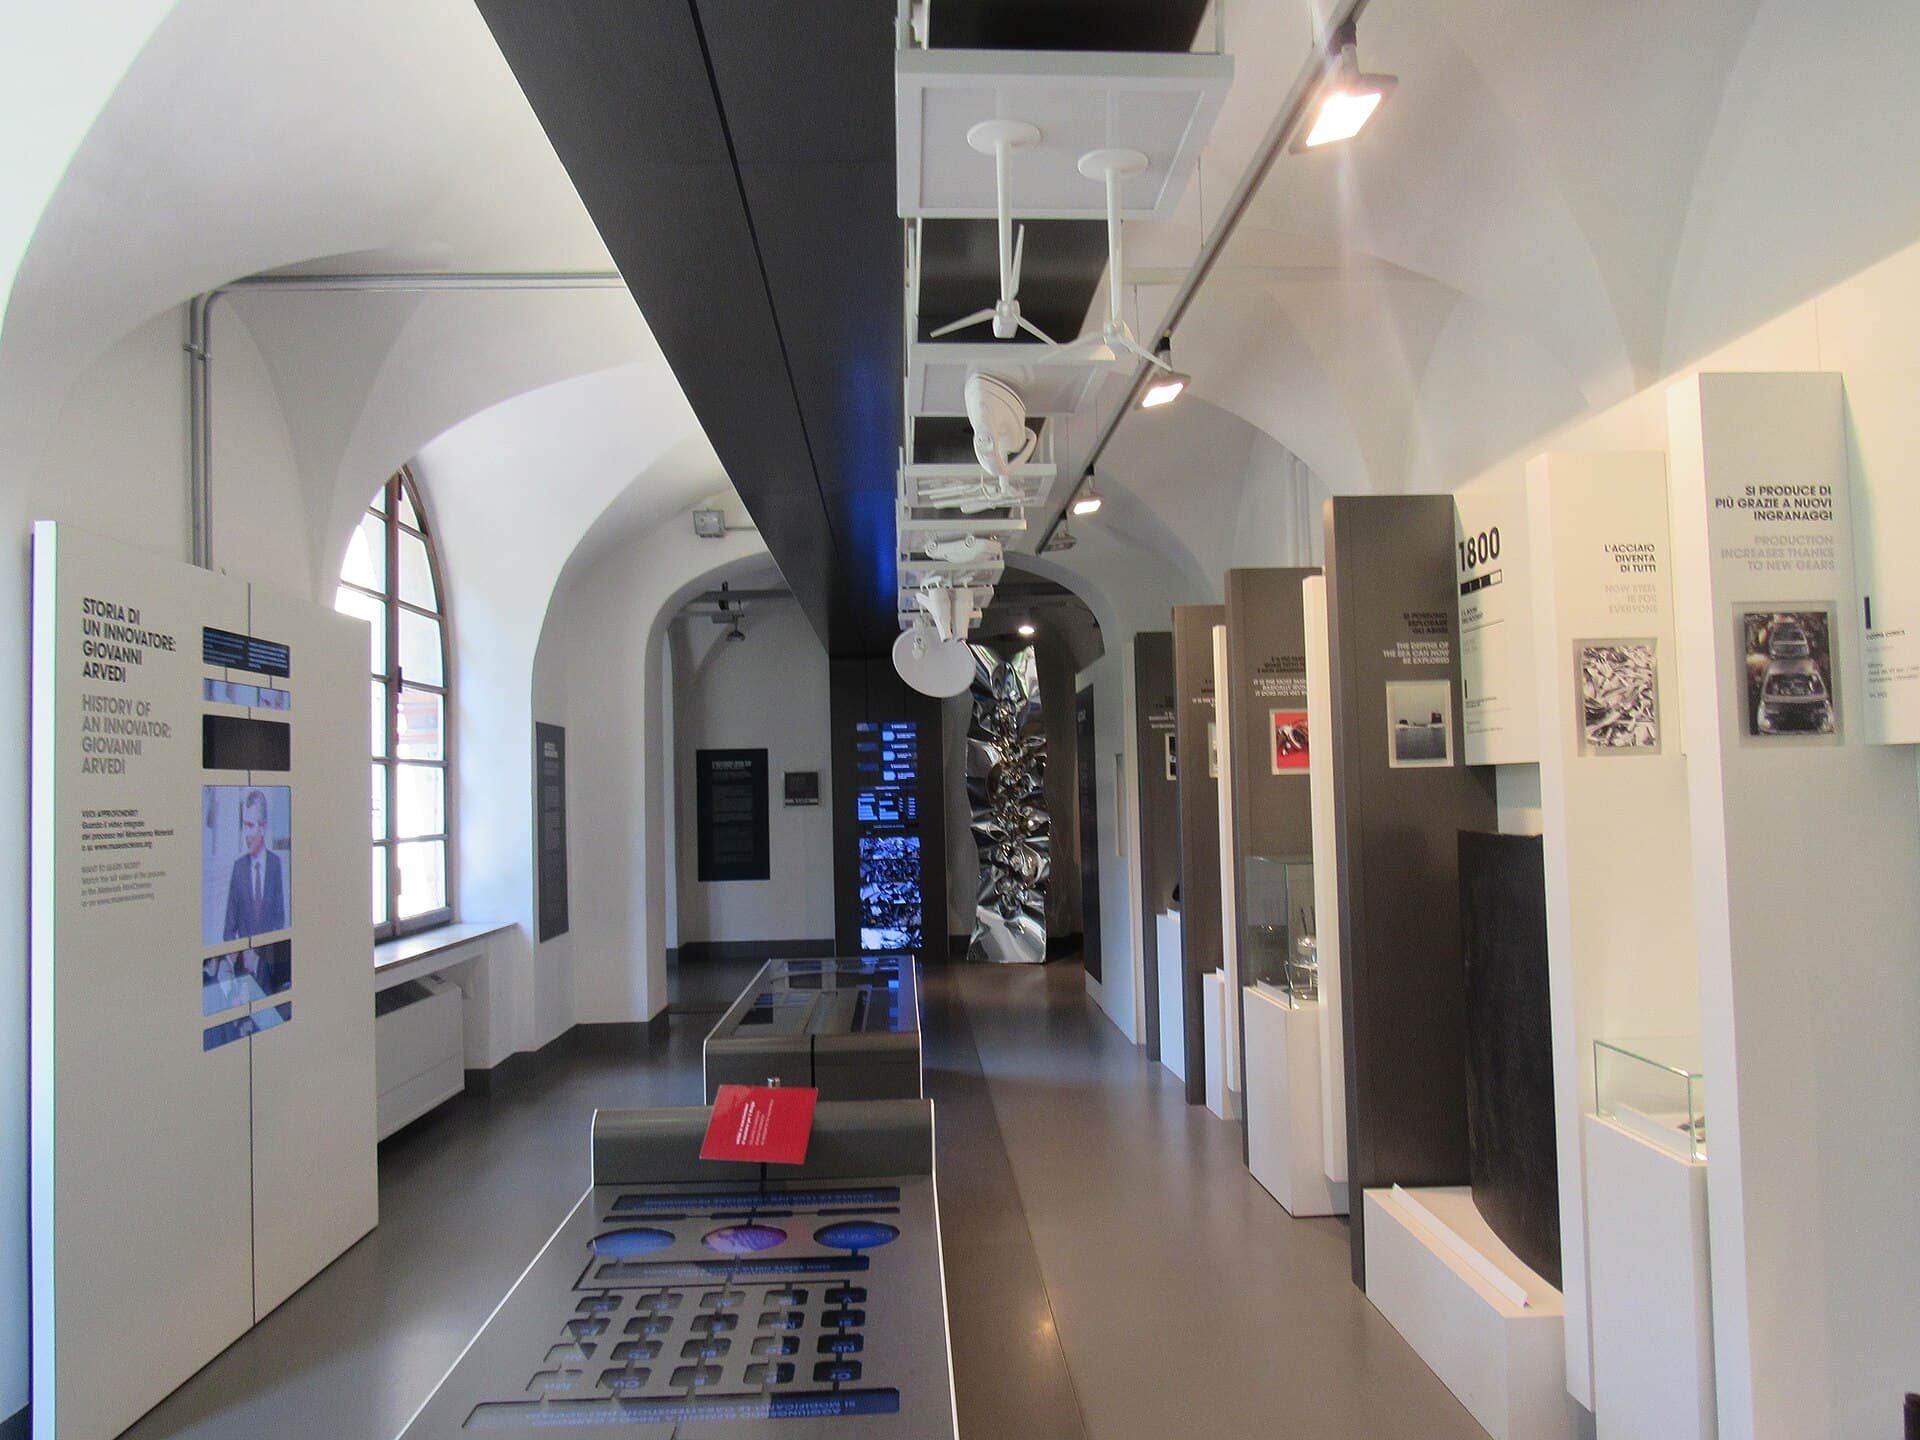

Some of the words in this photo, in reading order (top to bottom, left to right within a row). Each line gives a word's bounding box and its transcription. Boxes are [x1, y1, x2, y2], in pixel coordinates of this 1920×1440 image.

[1745, 486, 1755, 497] SI
[1759, 485, 1816, 497] PRODUCE
[1819, 485, 1831, 497] DI
[1715, 496, 1734, 509] PIÙ
[1738, 498, 1779, 509] GRAZIE
[1782, 498, 1791, 509] A
[1794, 498, 1832, 509] NUOVI
[1754, 510, 1833, 521] INGRANAGGI
[1754, 535, 1833, 546] PRODUCTION
[1458, 526, 1501, 571] 1800
[1604, 544, 1656, 553] L'ACCIAIO
[1721, 547, 1785, 559] INCREASES
[1787, 547, 1834, 558] THANKS
[1615, 554, 1656, 563] DIVENTA
[1620, 564, 1631, 573] DI
[1633, 564, 1657, 573] TUTTI
[1747, 560, 1763, 571] TO
[1766, 560, 1793, 571] NEW
[1796, 560, 1836, 571] GEARS
[83, 597, 124, 623] STORIA
[127, 609, 140, 625] DI
[83, 618, 101, 637] UN
[104, 623, 177, 652] INNOVATORE:
[1396, 641, 1409, 650] THE
[83, 640, 143, 665] GIOVANNI
[1383, 649, 1396, 658] THE
[1411, 649, 1429, 658] CAN
[1430, 649, 1449, 657] NOW
[1412, 657, 1450, 665] EXPLORED
[82, 661, 127, 683] ARVEDI
[82, 695, 132, 716] HISTORY
[136, 701, 152, 718] OF
[82, 716, 101, 733] AN
[104, 717, 172, 739] INNOVATOR:
[82, 737, 142, 756] GIOVANNI
[82, 758, 126, 774] ARVEDI
